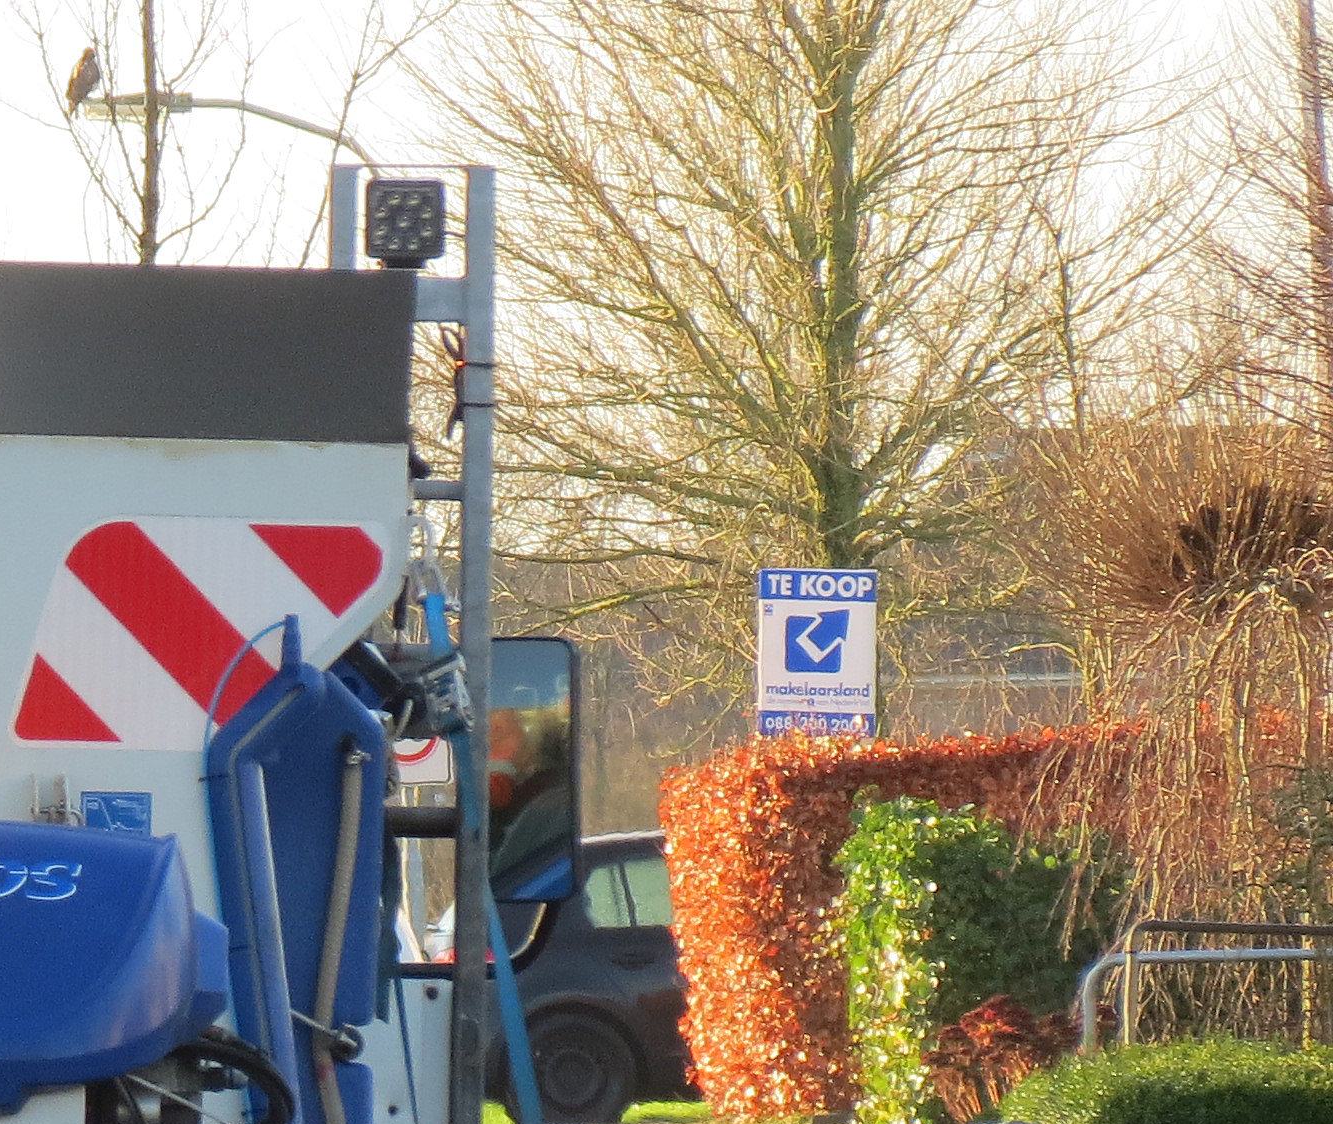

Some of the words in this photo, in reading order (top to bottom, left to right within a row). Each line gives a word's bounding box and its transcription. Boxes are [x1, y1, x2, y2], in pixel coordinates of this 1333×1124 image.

[769, 575, 792, 595] TE
[801, 576, 872, 597] KOOP
[766, 682, 869, 697] makelaarsland
